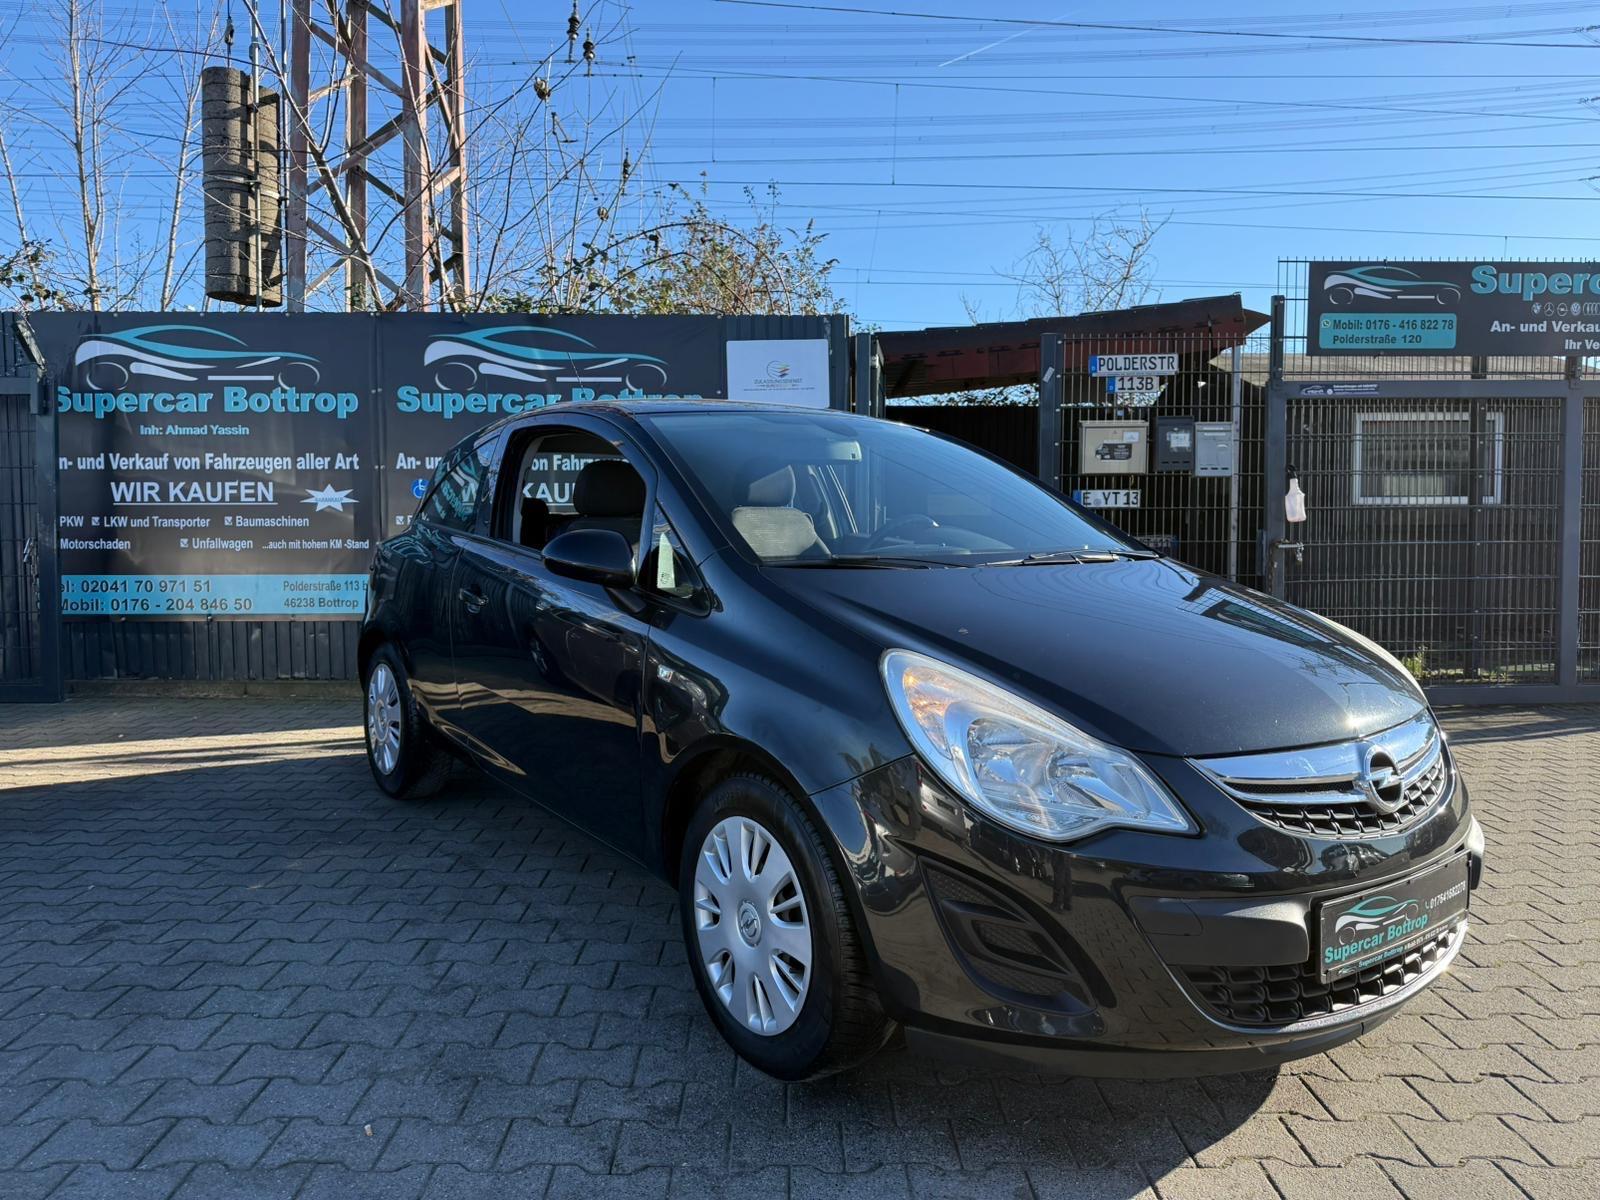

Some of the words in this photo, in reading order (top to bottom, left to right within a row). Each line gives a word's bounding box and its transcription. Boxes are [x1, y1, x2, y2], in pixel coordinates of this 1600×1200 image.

[1332, 319, 1362, 330] Mobil:
[1365, 319, 1390, 330] 0176
[1399, 319, 1417, 330] 416
[1420, 319, 1438, 330] 822
[1442, 319, 1454, 330] 78
[1490, 320, 1516, 333] An-
[1520, 320, 1547, 333] und
[1332, 334, 1397, 345] Polderstraße
[1401, 334, 1422, 344] 120
[1565, 339, 1582, 350] Ihr
[1098, 356, 1175, 372] POLDERSTR
[1117, 376, 1154, 391] 113B
[58, 385, 213, 419] Supercar
[223, 386, 359, 419] Bottrop
[140, 424, 163, 435] Inh:
[165, 424, 208, 435] Ahmad
[210, 424, 250, 435] Yassin
[59, 456, 73, 470] n-
[77, 453, 105, 470] und
[109, 453, 169, 470] Verkauf
[173, 457, 200, 470] von
[204, 453, 292, 474] Fahrzeugen
[296, 453, 331, 470] aller
[335, 452, 360, 470] Art
[395, 452, 421, 470] An-
[425, 455, 443, 470] un
[531, 459, 549, 471] on
[110, 482, 161, 502] WIR
[168, 481, 274, 502] KAUFEN
[59, 515, 84, 527] PKW
[103, 515, 128, 528] LKW
[130, 516, 150, 528] und
[152, 515, 211, 530] Transporter
[235, 515, 310, 527] Baumaschinen
[60, 538, 131, 550] Motorschaden
[192, 537, 253, 551] Unfallwagen
[288, 539, 301, 549] mit
[302, 539, 328, 549] hohem
[329, 539, 342, 549] KM
[59, 580, 75, 593] el:
[81, 580, 129, 593] 02041
[134, 580, 154, 593] 70
[159, 580, 186, 593] 971
[193, 580, 211, 593] 51
[283, 580, 342, 592] Polderstraße
[344, 580, 360, 591] 113
[60, 598, 104, 611] Mobil:
[111, 598, 150, 611] 0176
[166, 598, 194, 611] 204
[200, 598, 229, 611] 846
[233, 598, 252, 611] 50
[284, 597, 315, 608] 46238
[318, 597, 359, 609] Bottrop
[1324, 932, 1385, 965] Supercar
[1386, 913, 1428, 941] Bottrop
